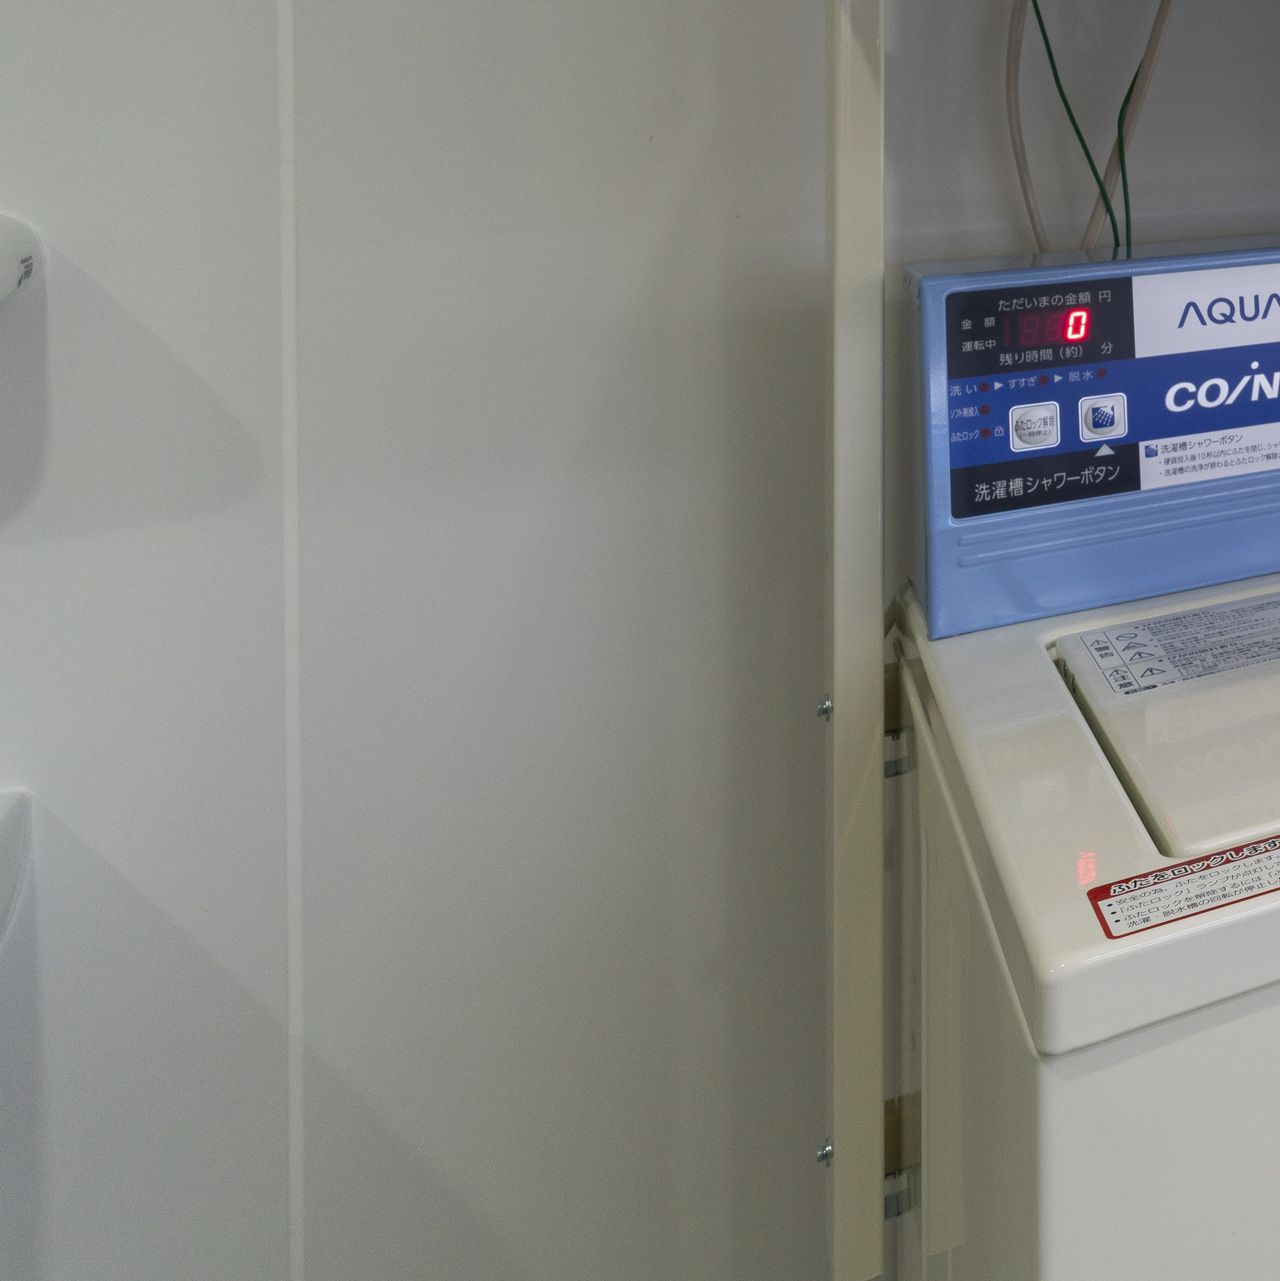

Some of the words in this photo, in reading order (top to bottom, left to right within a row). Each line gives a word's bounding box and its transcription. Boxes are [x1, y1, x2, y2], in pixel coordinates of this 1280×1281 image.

[998, 291, 1091, 312] ただいまの金額
[1099, 290, 1111, 303] 円
[1067, 311, 1087, 340] 0
[961, 340, 997, 352] 運転中
[1101, 342, 1113, 355] 分
[1008, 377, 1037, 389] すすぎ
[1068, 369, 1093, 382] 脱水
[1161, 434, 1243, 455] 洗濯槽シャワーボタン
[974, 465, 1120, 502] 洗濯槽シャワーボタン
